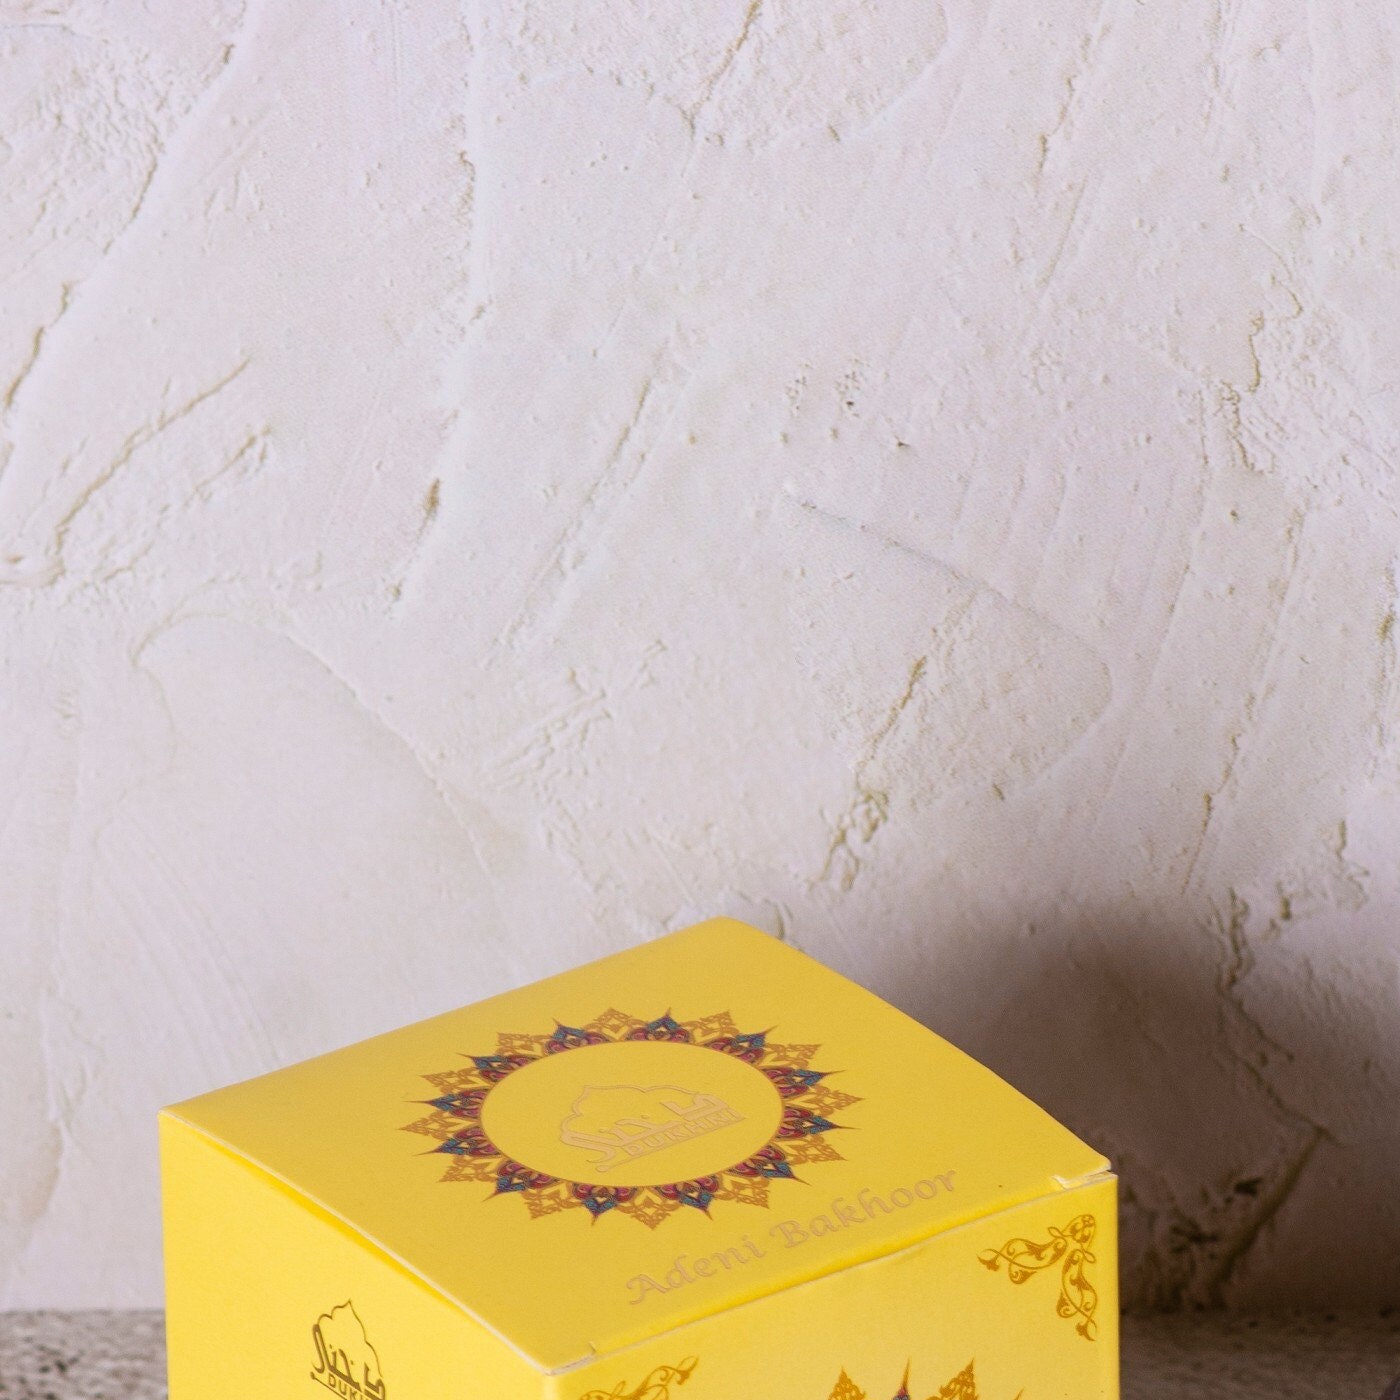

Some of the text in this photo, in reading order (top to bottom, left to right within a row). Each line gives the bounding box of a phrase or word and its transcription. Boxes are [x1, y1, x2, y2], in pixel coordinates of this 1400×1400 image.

[621, 1106, 745, 1157] DUKHNI
[626, 1169, 956, 1305] Adeni Bakhoor
